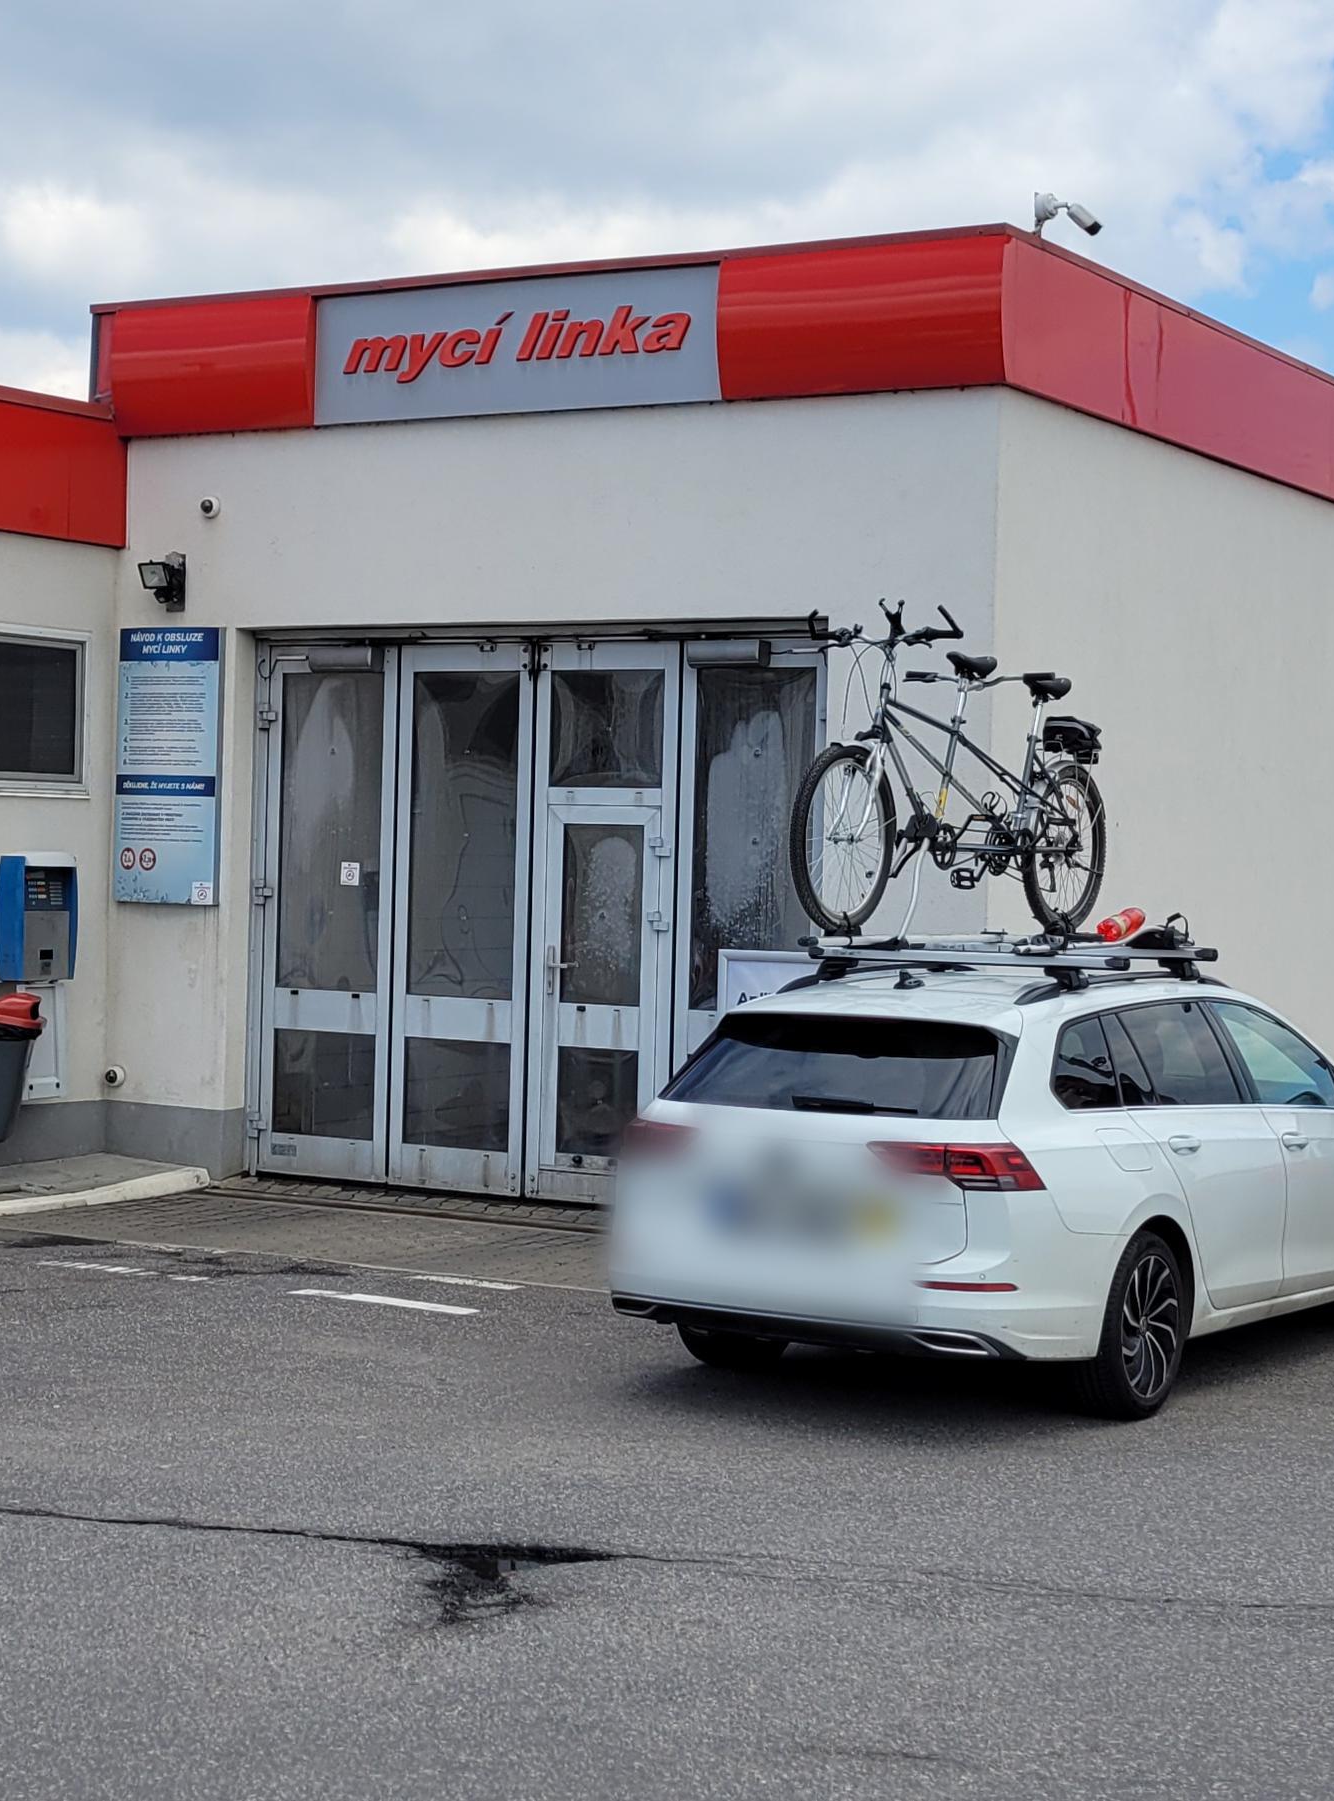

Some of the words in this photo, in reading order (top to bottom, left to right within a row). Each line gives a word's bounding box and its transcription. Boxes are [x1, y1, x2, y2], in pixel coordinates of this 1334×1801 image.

[342, 310, 515, 384] mycí
[516, 304, 692, 363] linka
[130, 631, 156, 643] NÁVOD
[156, 632, 164, 642] K
[164, 632, 204, 642] OBSLUZE
[161, 644, 188, 654] LINKY
